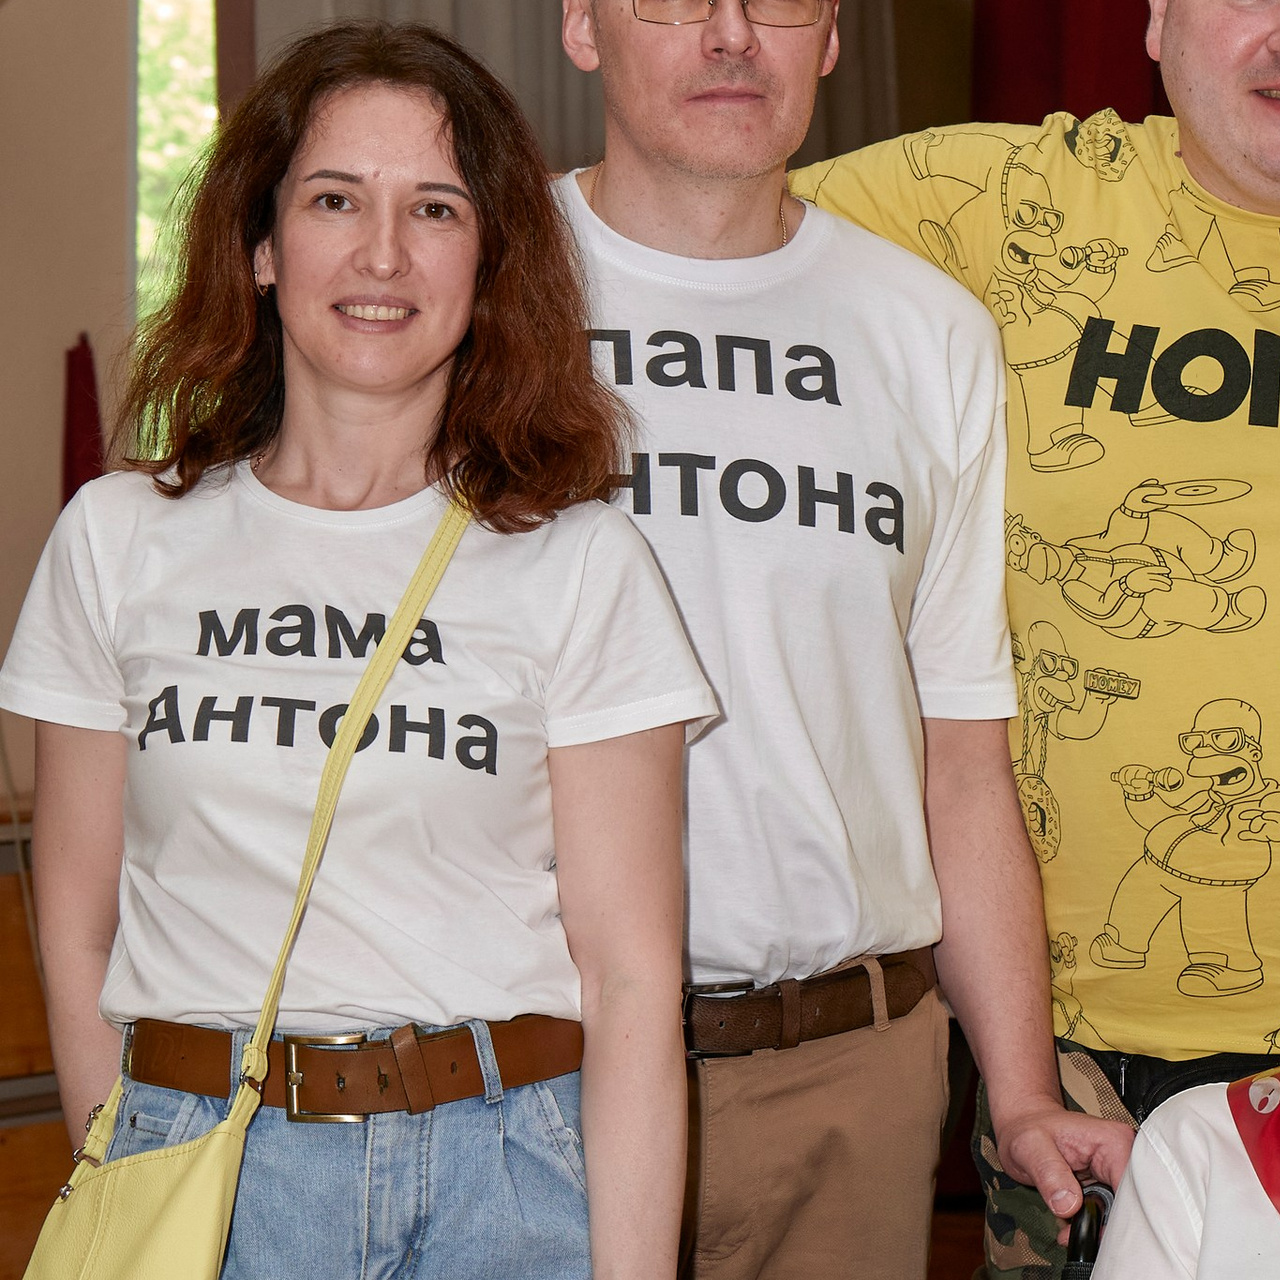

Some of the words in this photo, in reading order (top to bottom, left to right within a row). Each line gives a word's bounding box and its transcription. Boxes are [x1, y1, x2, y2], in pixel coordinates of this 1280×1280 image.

[585, 328, 842, 407] папа
[606, 452, 906, 556] нтона
[196, 604, 447, 666] мама
[1088, 673, 1139, 696] HOMEY
[138, 684, 499, 776] Антона
